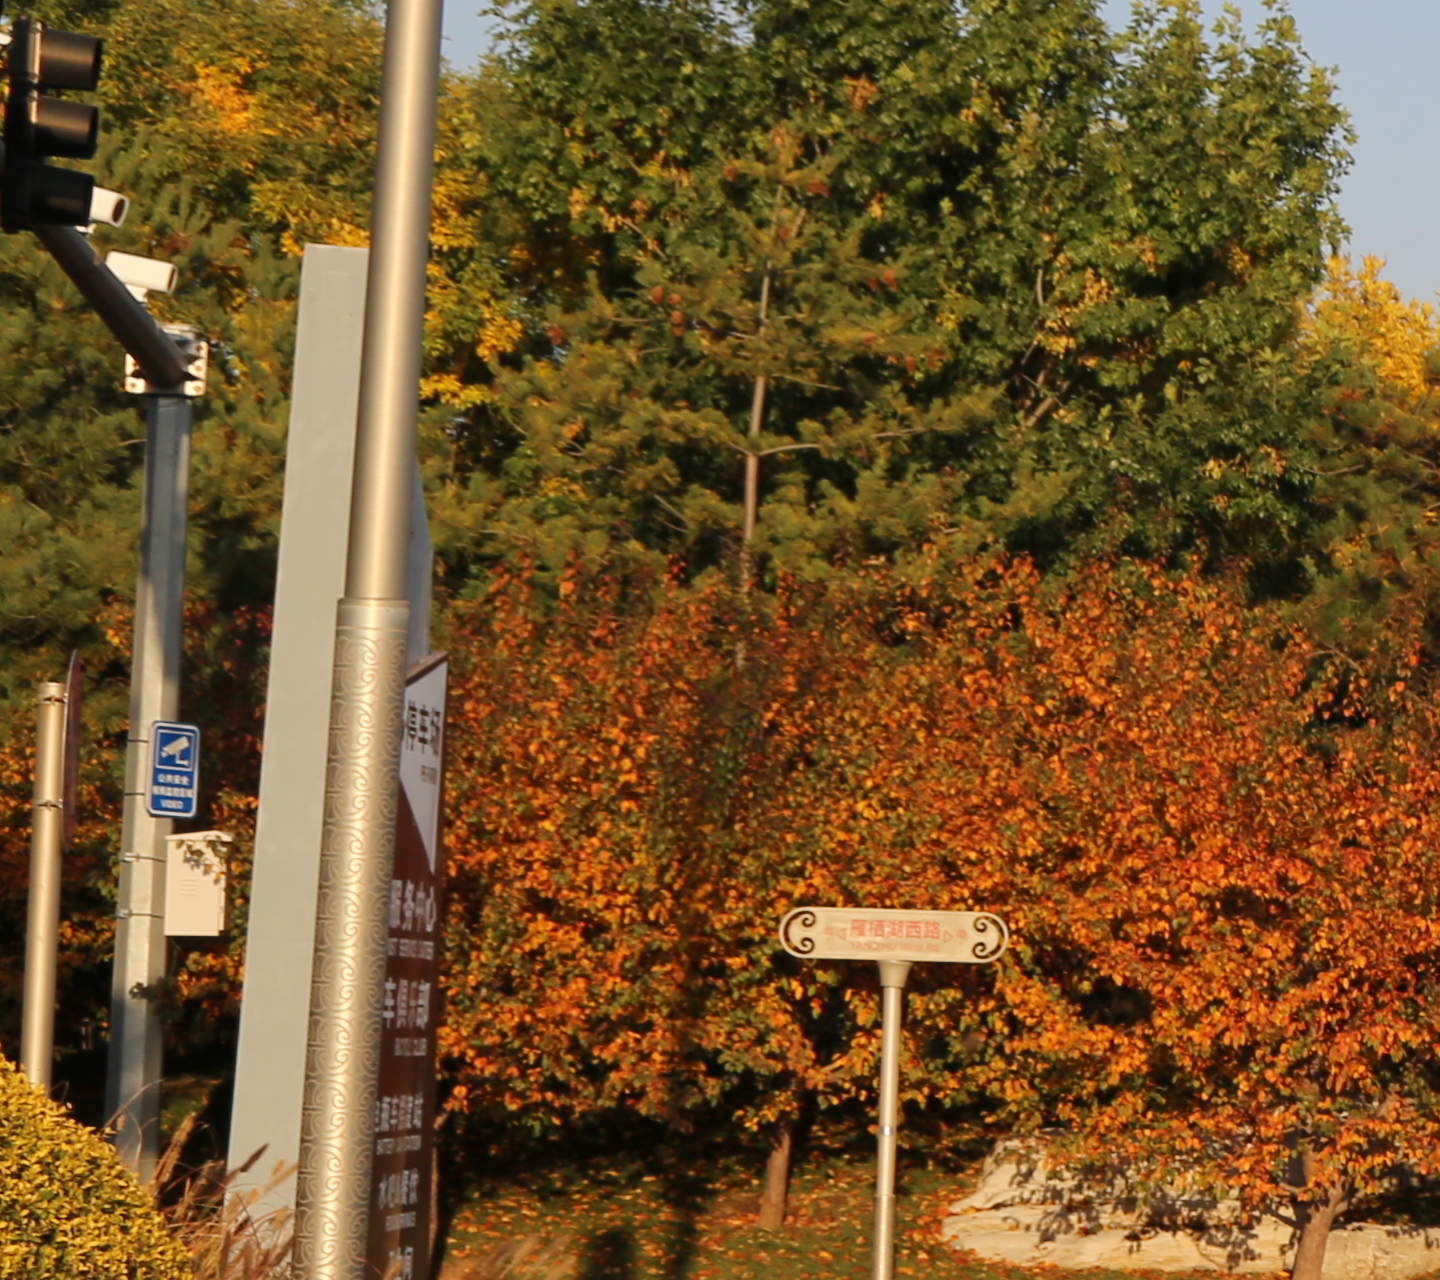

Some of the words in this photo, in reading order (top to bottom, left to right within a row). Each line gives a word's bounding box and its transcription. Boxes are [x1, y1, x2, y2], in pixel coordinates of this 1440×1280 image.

[160, 799, 184, 809] VIDEO
[850, 919, 941, 939] 雁栖湖西路
